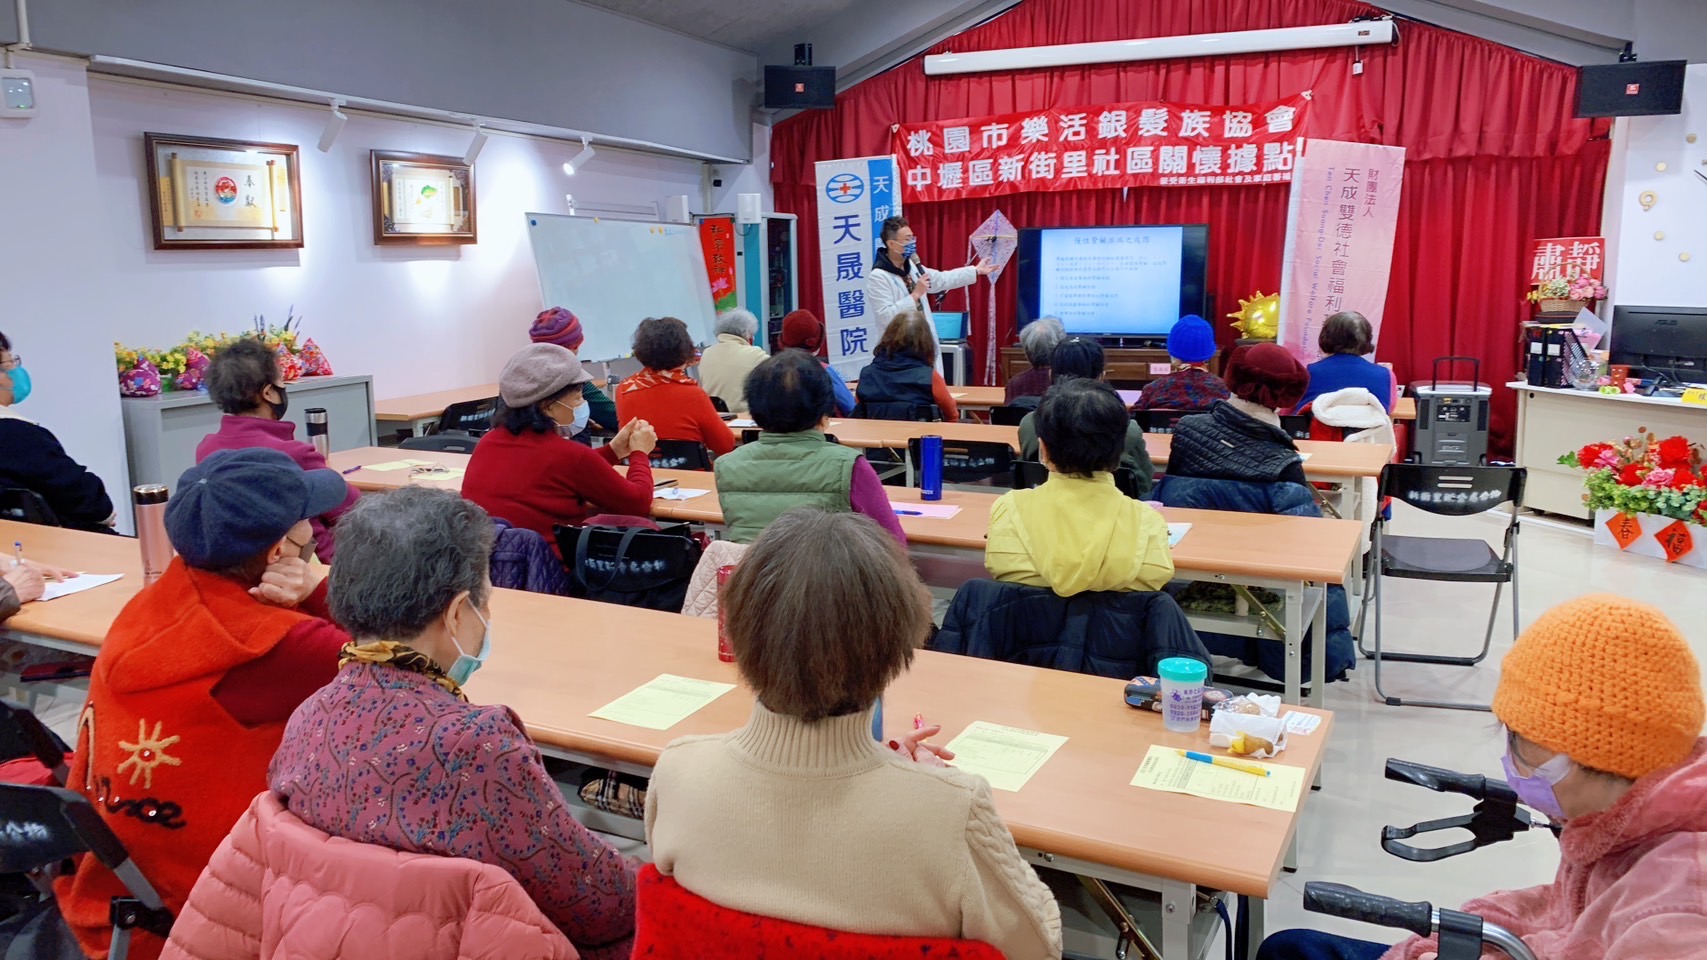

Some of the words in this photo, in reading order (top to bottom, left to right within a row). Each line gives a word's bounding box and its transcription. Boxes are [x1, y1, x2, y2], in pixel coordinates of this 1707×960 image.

[907, 104, 1297, 157] 桃園市樂活銀髮族協會
[907, 141, 1295, 191] 中壢區新街里社區關懷據點
[1363, 168, 1379, 218] 財團法人
[1323, 167, 1361, 328] 天成雙德社會福利
[1531, 241, 1600, 281] 肅靜
[833, 214, 868, 356] 天晟醫院
[1619, 516, 1633, 539] 春
[1665, 527, 1686, 555] 福
